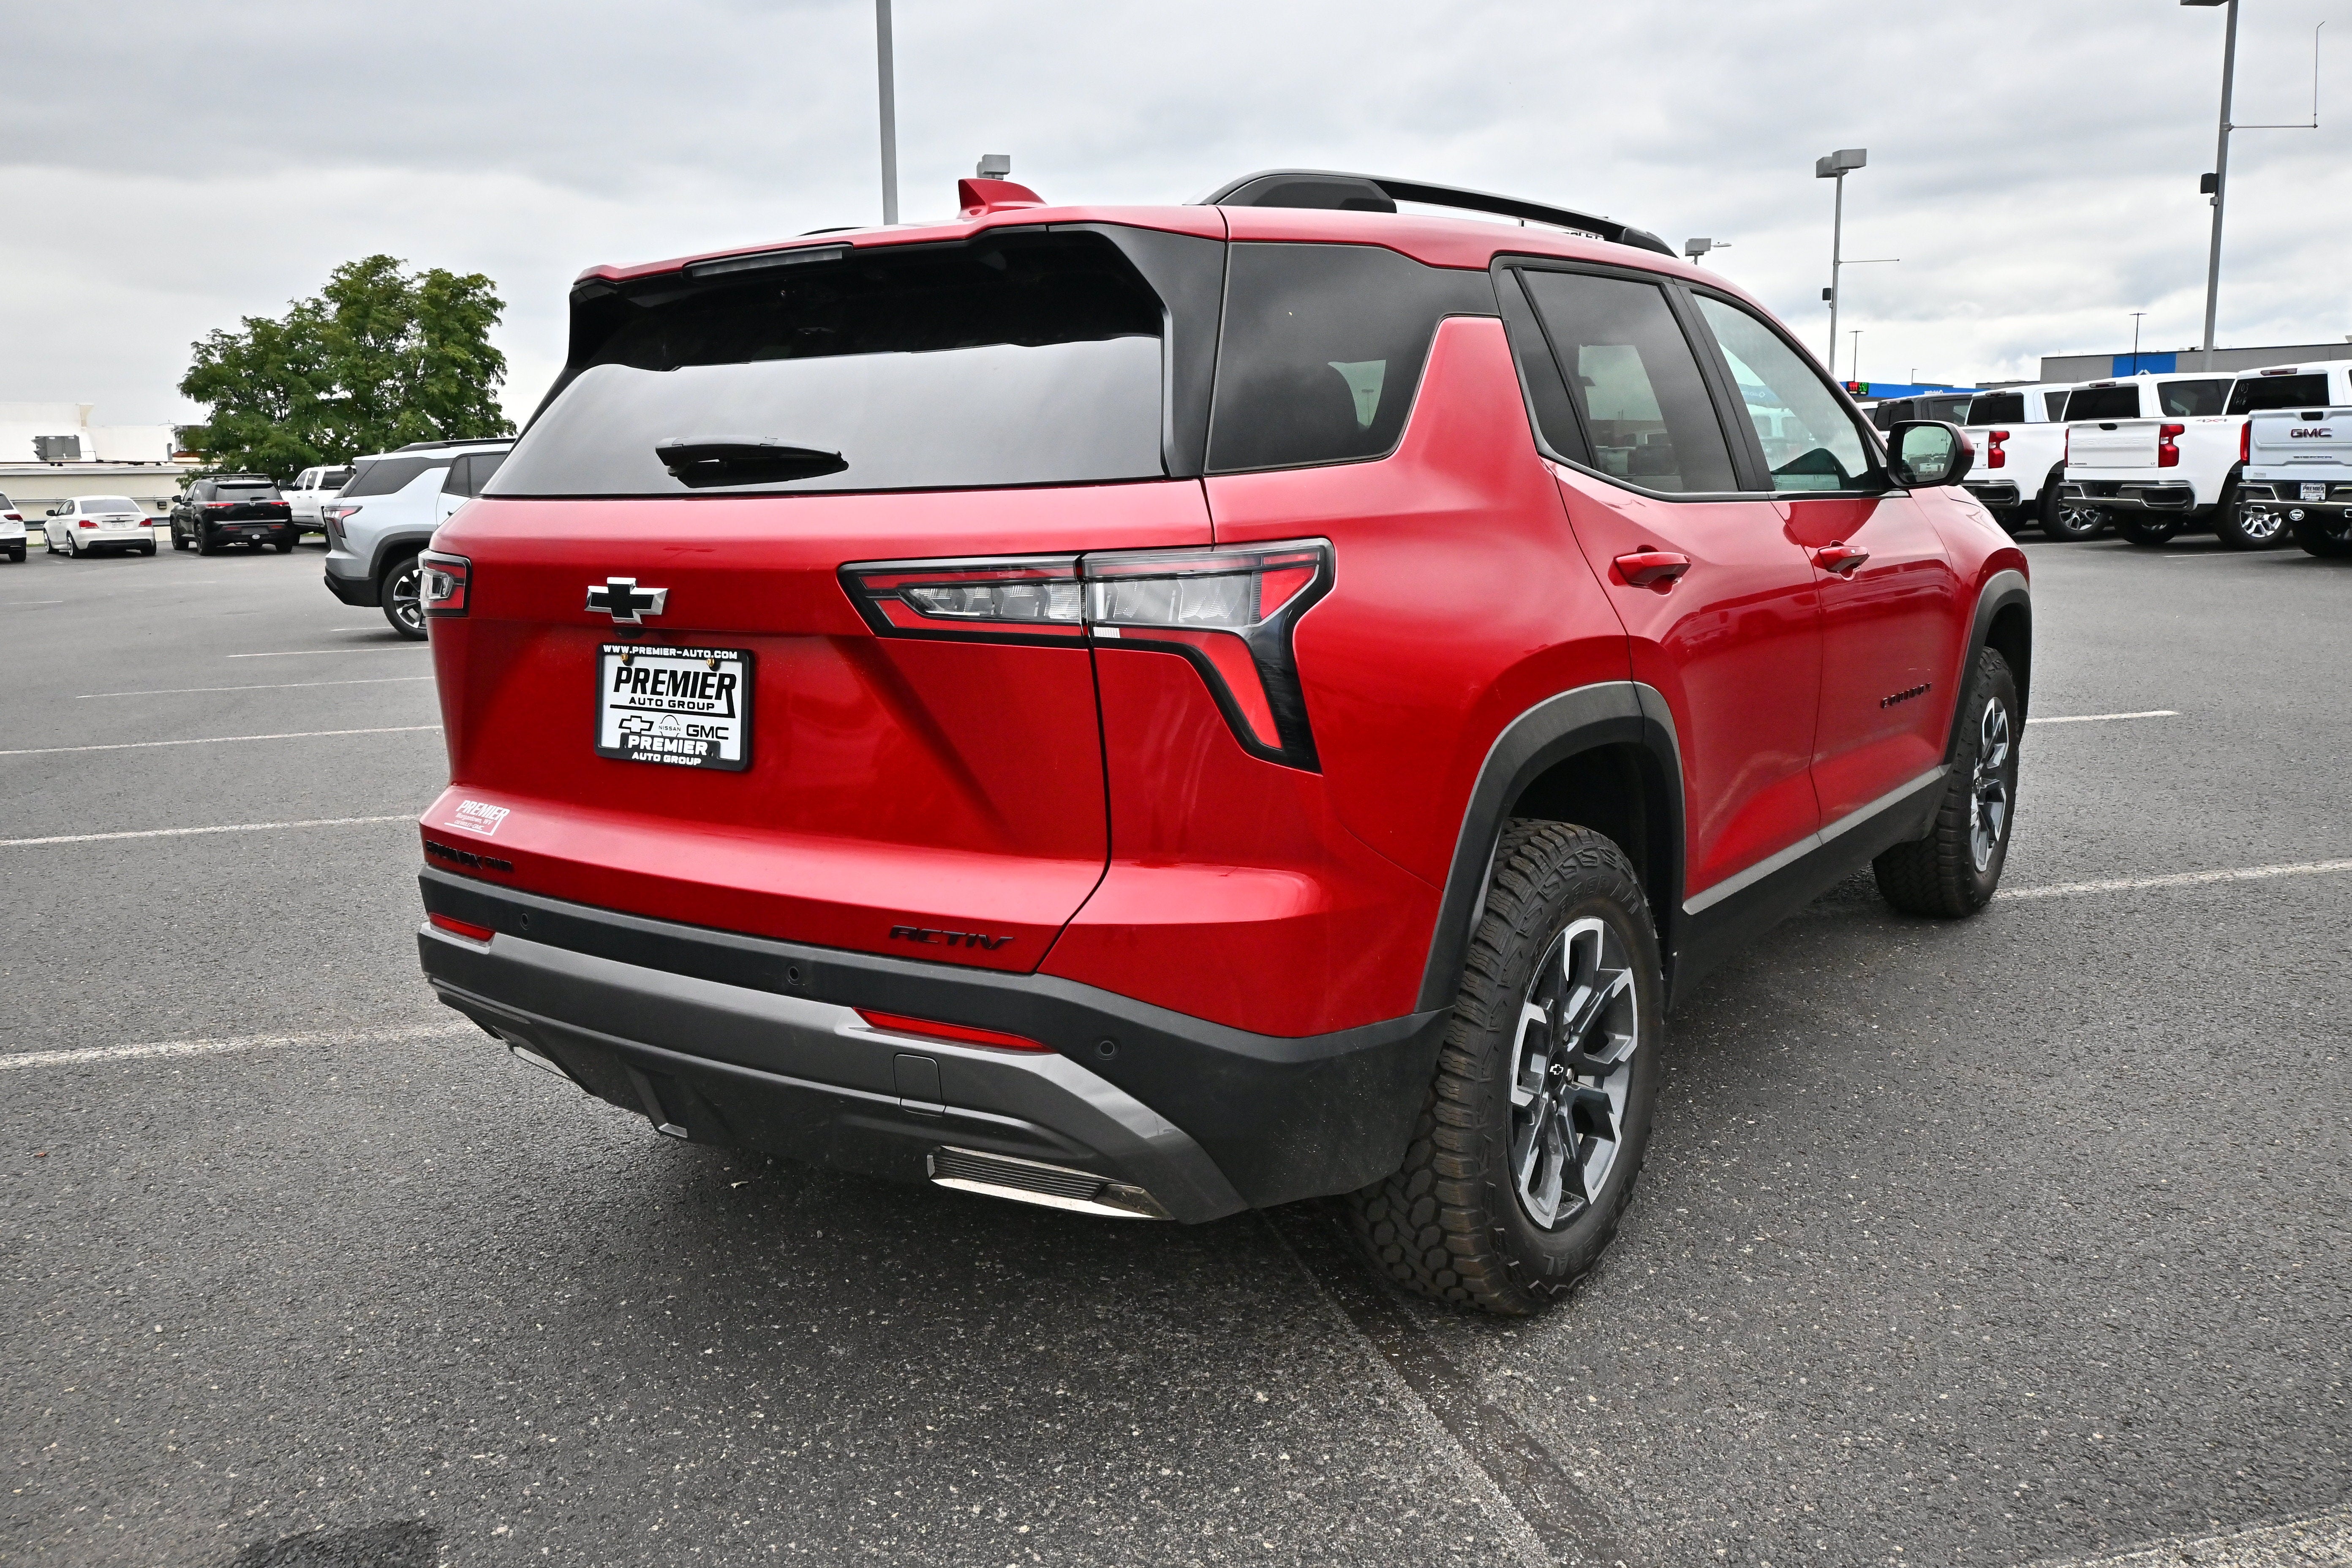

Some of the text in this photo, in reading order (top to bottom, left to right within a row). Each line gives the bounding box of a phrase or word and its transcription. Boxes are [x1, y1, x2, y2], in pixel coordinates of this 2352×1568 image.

[2291, 428, 2332, 438] GMC
[603, 645, 738, 659] WWW.PREMIER-AUTO.COM
[613, 666, 737, 701] PREMIER
[629, 697, 715, 710] AUTO GROUP
[686, 724, 729, 740] GMC
[628, 735, 708, 756] PREMIER
[632, 752, 702, 766] AUTO GROUP
[455, 800, 510, 821] PREMIER
[889, 925, 1014, 950] ACTIV
